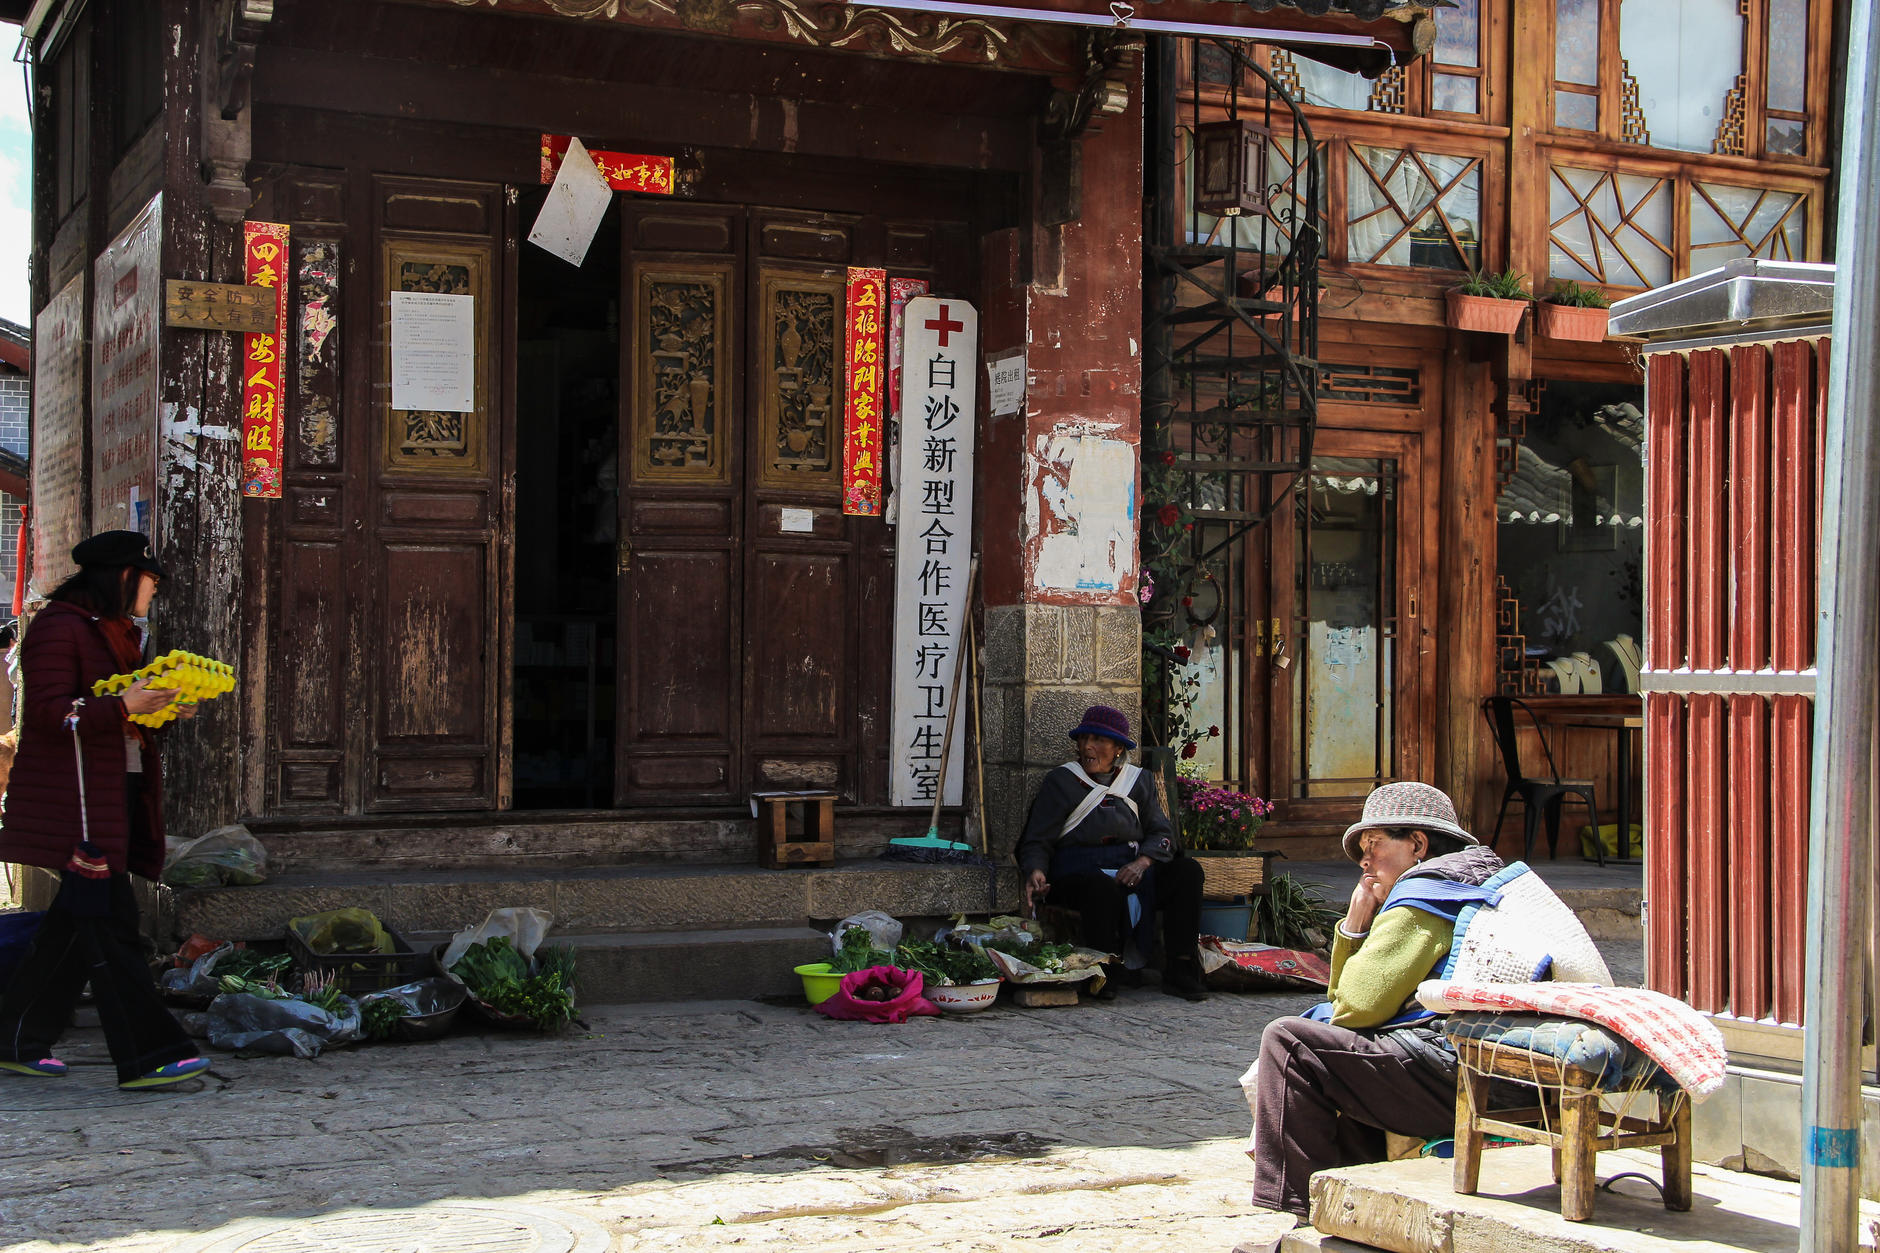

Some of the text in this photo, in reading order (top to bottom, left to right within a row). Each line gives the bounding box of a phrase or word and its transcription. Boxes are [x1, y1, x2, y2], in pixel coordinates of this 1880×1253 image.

[177, 285, 266, 308] 安全防火
[909, 352, 960, 801] 白沙新型合作医疗卫生室
